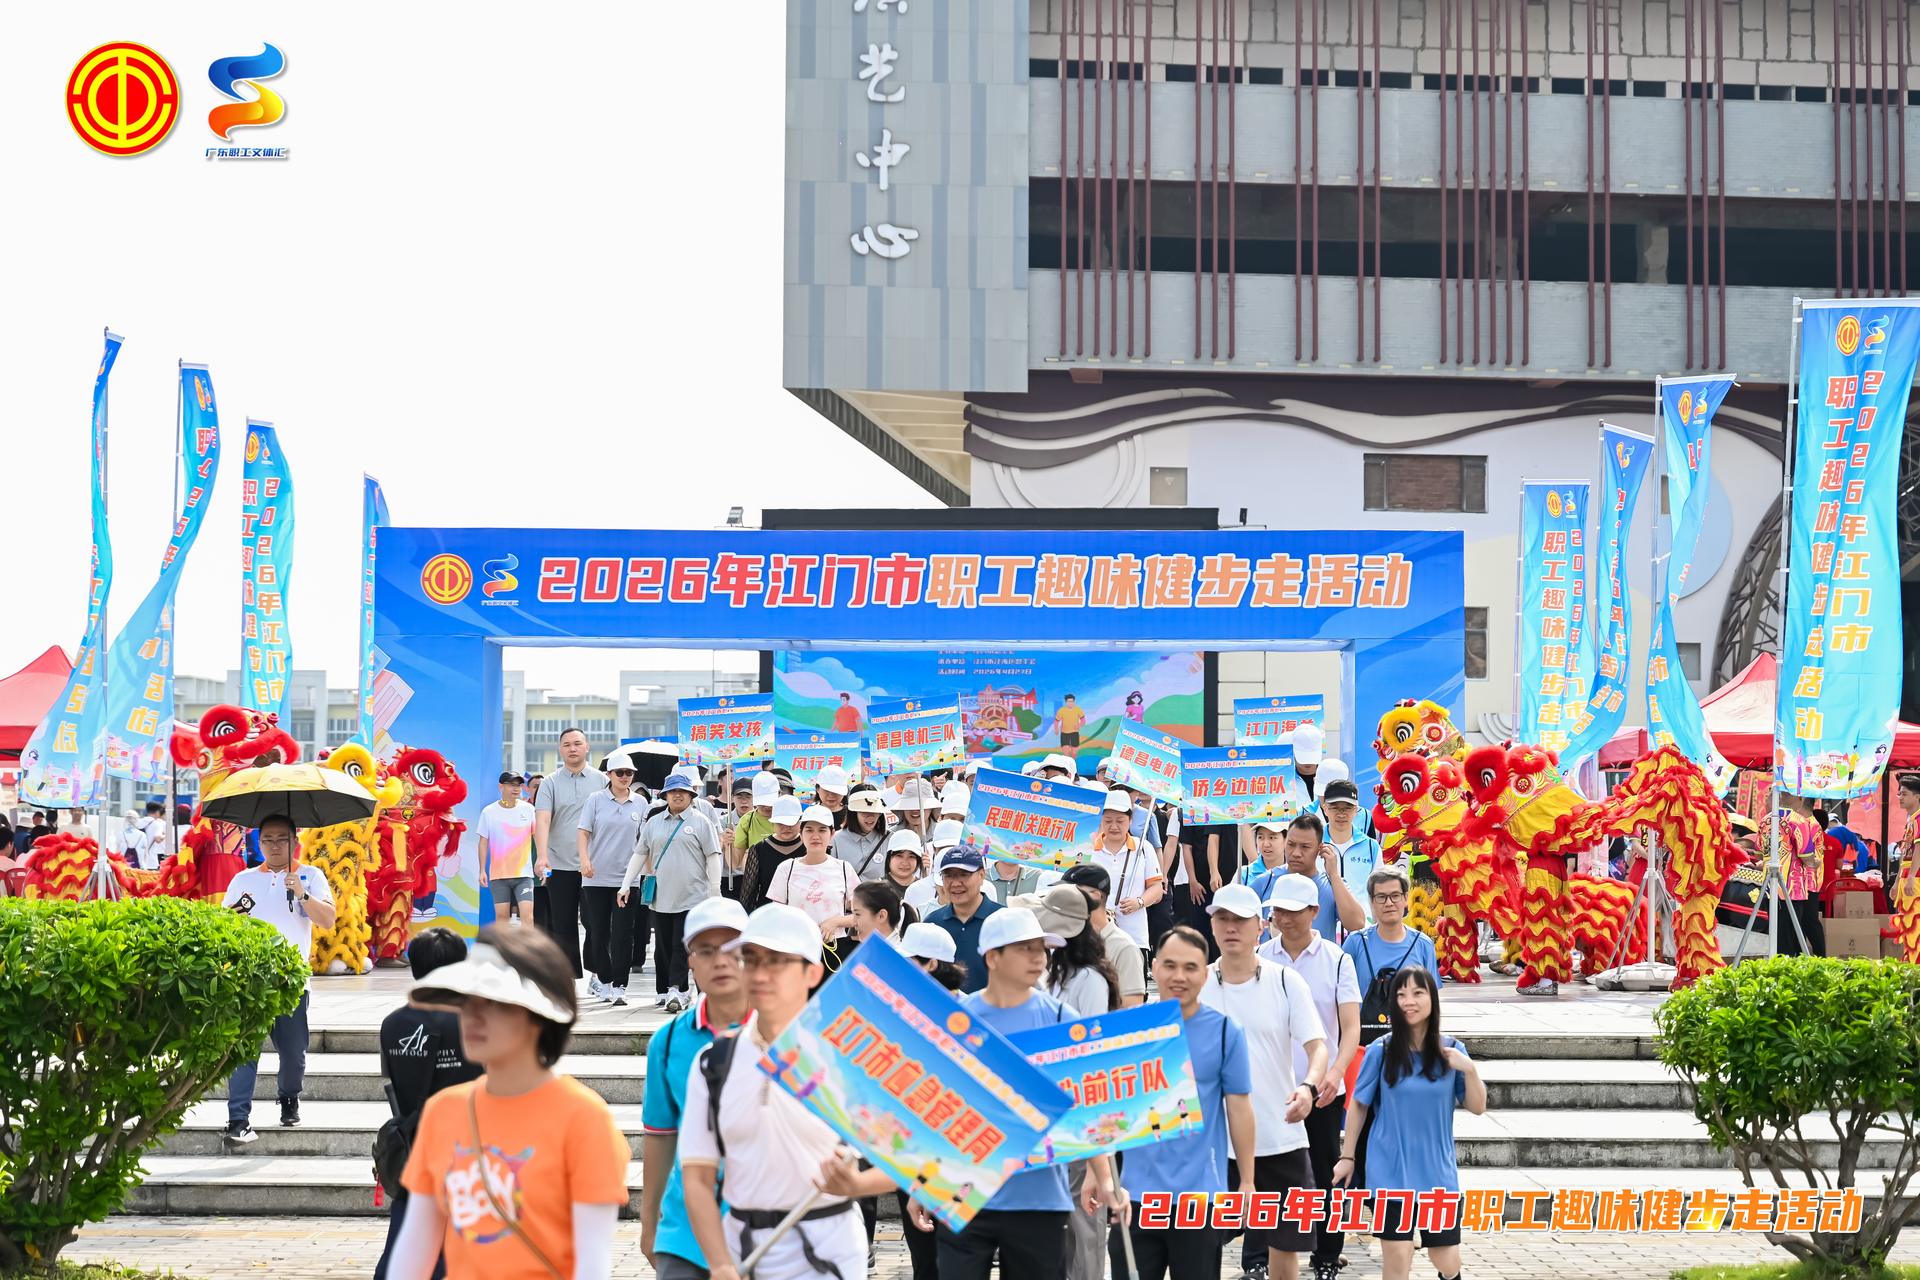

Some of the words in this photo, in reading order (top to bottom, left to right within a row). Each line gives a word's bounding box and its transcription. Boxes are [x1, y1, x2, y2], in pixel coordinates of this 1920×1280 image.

[850, 0, 920, 259] 艺中心
[1831, 367, 1885, 655] 2026年江门市
[537, 551, 1414, 609] 2026年江门市职工趣味健步走活动
[1793, 374, 1859, 743] 职工趣味健步走活动
[690, 719, 764, 742] 搞笑女孩
[876, 723, 956, 750] 德昌电机三队
[1119, 742, 1181, 780] 德昌电机
[1191, 775, 1287, 798] 侨乡边检队
[985, 804, 1079, 843] 民盟机关健行队
[820, 1004, 1008, 1166] 江门市应急管理局
